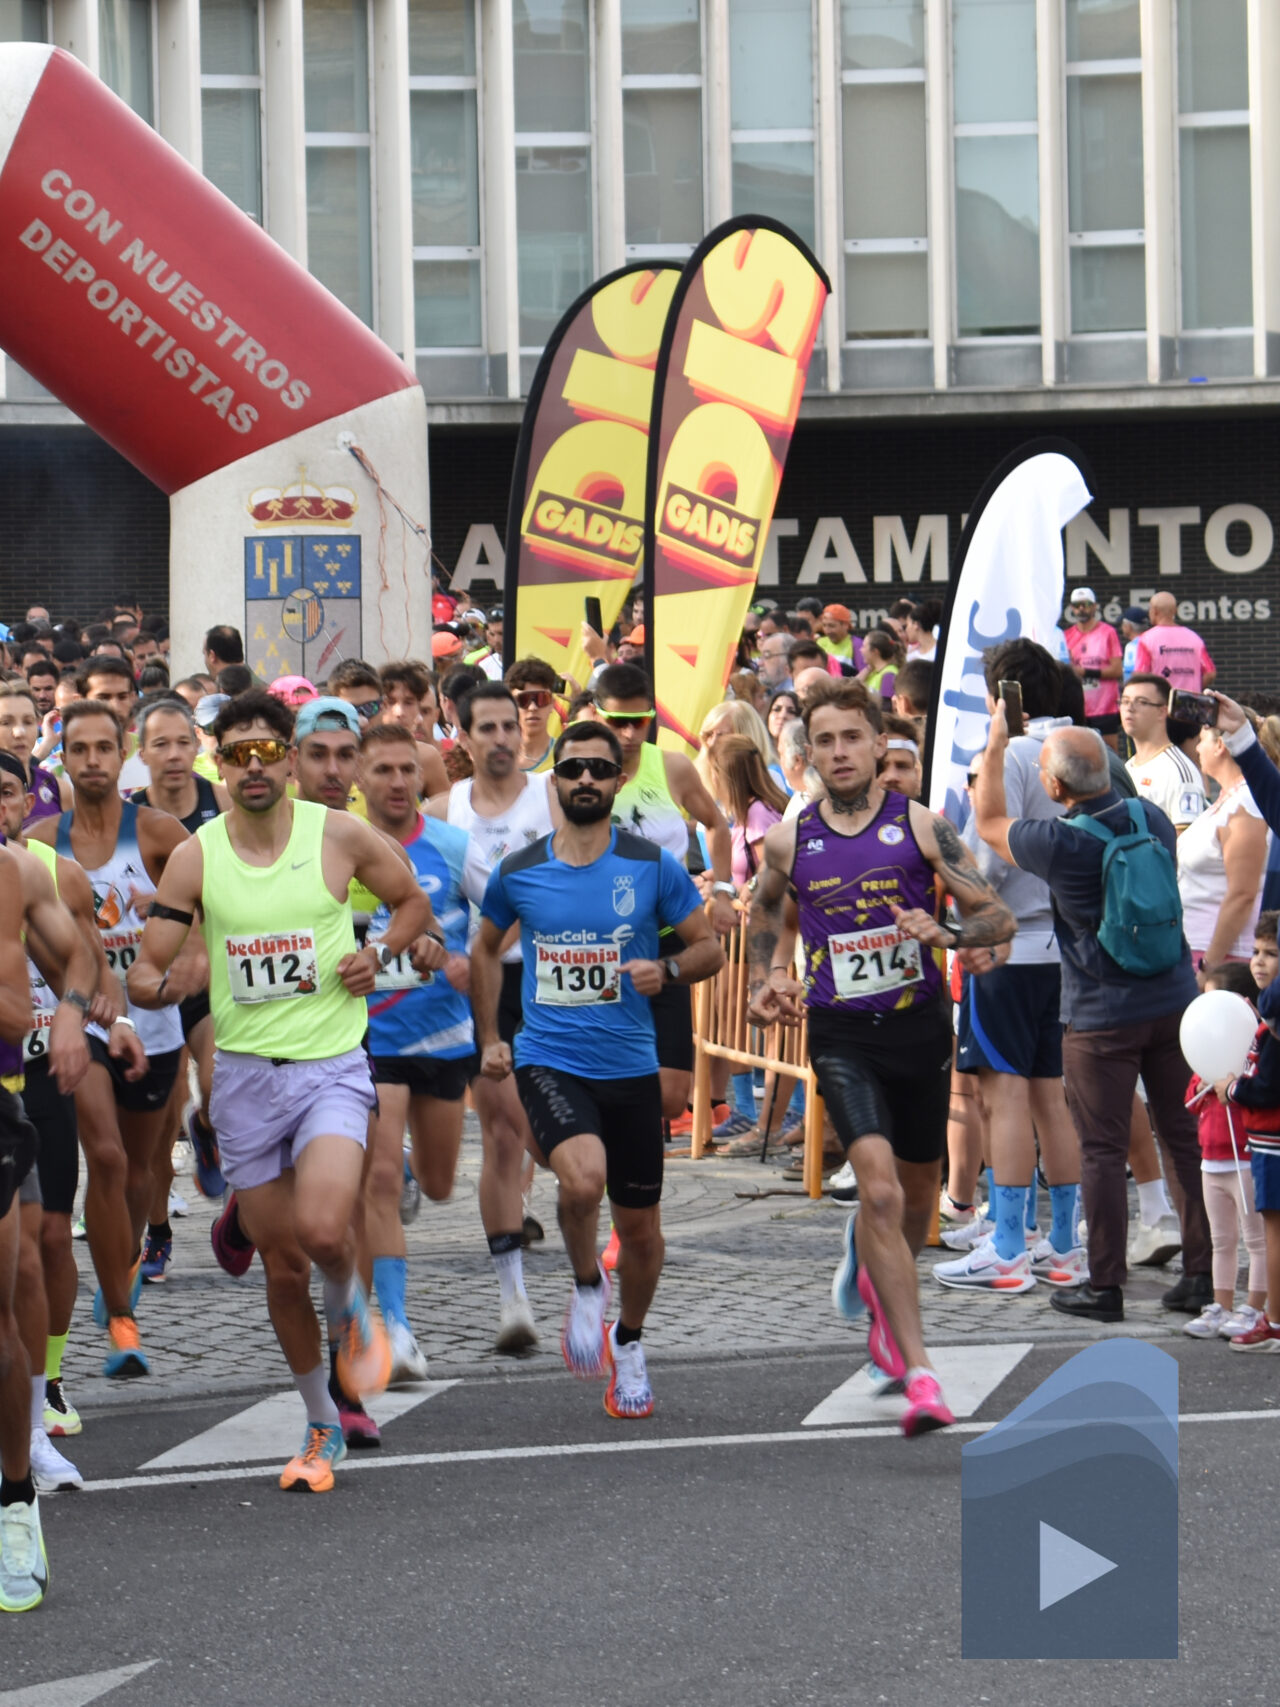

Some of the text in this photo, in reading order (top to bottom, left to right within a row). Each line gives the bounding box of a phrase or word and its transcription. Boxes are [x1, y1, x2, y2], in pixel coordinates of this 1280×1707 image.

[41, 169, 311, 410] CON NUESTROS
[19, 218, 259, 433] DEPORTISTAS
[449, 503, 1274, 591] ATAMNTO
[536, 499, 644, 555] GADIS
[666, 494, 757, 556] GADIS
[226, 935, 312, 956] bedunia
[539, 947, 618, 965] bedunia
[849, 944, 907, 981] 214
[240, 954, 302, 987] 112
[552, 965, 606, 991] 130
